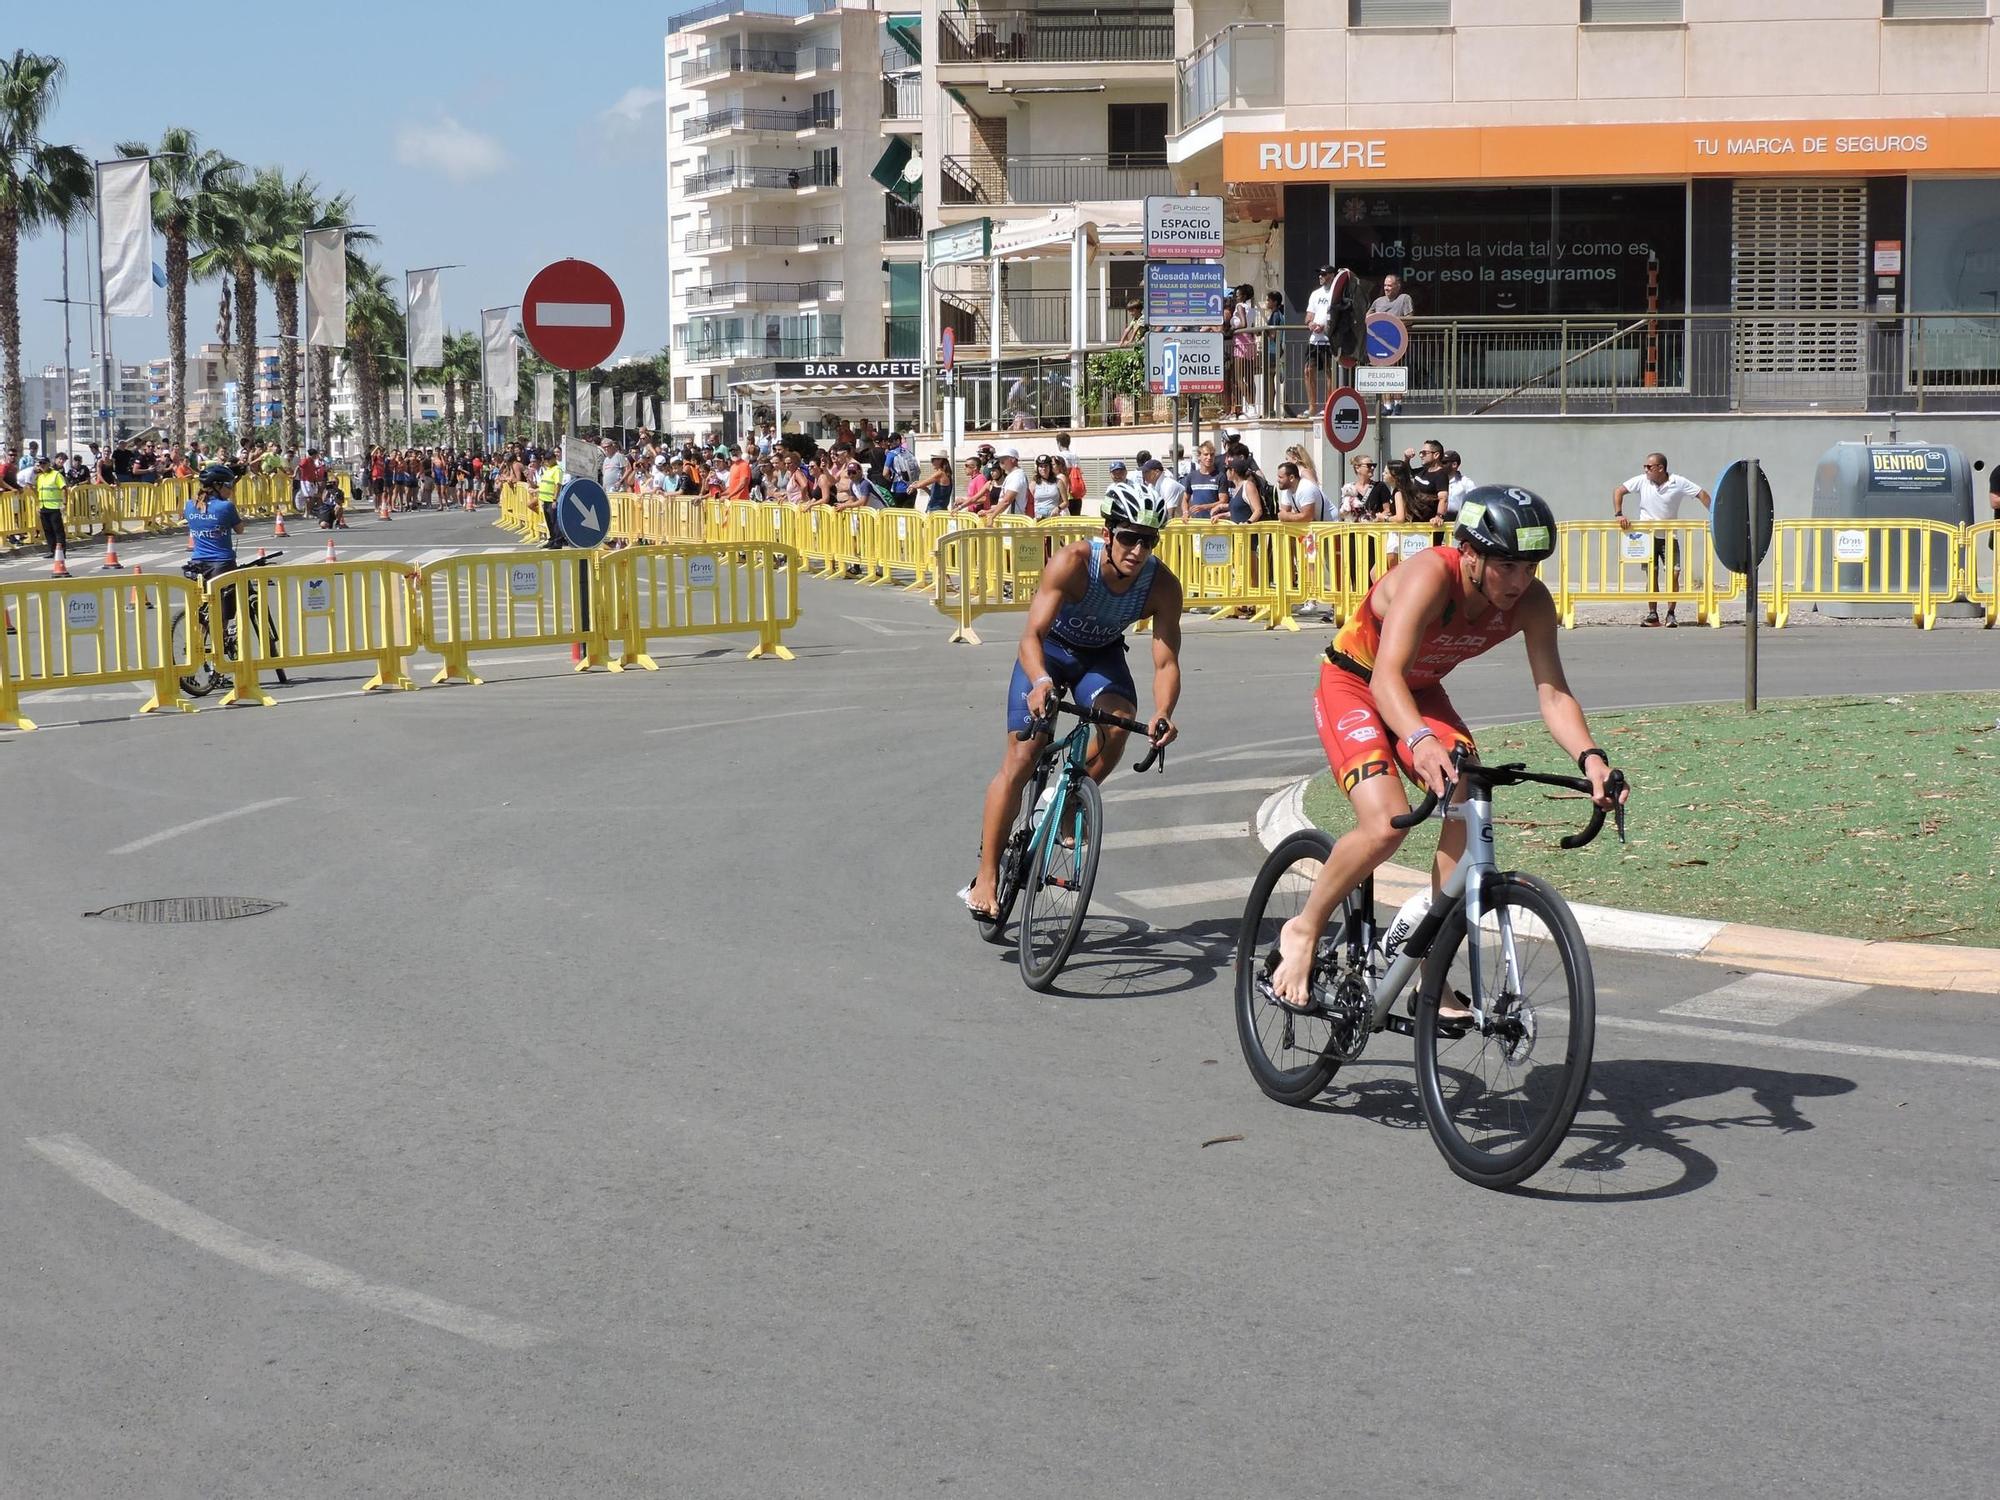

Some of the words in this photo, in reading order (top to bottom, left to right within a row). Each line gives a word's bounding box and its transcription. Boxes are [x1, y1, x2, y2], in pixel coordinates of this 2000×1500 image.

[1694, 139, 1719, 155] TU
[1727, 138, 1794, 154] MARCA
[1803, 137, 1828, 153] DE
[1835, 136, 1928, 153] SEGUROS
[1260, 140, 1387, 170] RUIZRE
[1161, 219, 1211, 228] ESPACIO
[1151, 230, 1220, 240] DISPONIBLE
[1371, 242, 1406, 258] Nos
[1412, 242, 1460, 261] gusta
[1467, 241, 1481, 257] la
[1487, 241, 1524, 257] vida
[1529, 240, 1550, 257] tal
[1556, 244, 1566, 260] y
[1572, 242, 1623, 256] como
[1151, 272, 1189, 281] Quesada
[1191, 272, 1220, 280] Market
[1403, 267, 1435, 282] Por
[1440, 269, 1473, 282] eso
[1479, 266, 1495, 281] la
[1500, 267, 1617, 285] aseguramos
[805, 364, 839, 376] BAR
[1872, 454, 1924, 471] DENTRO
